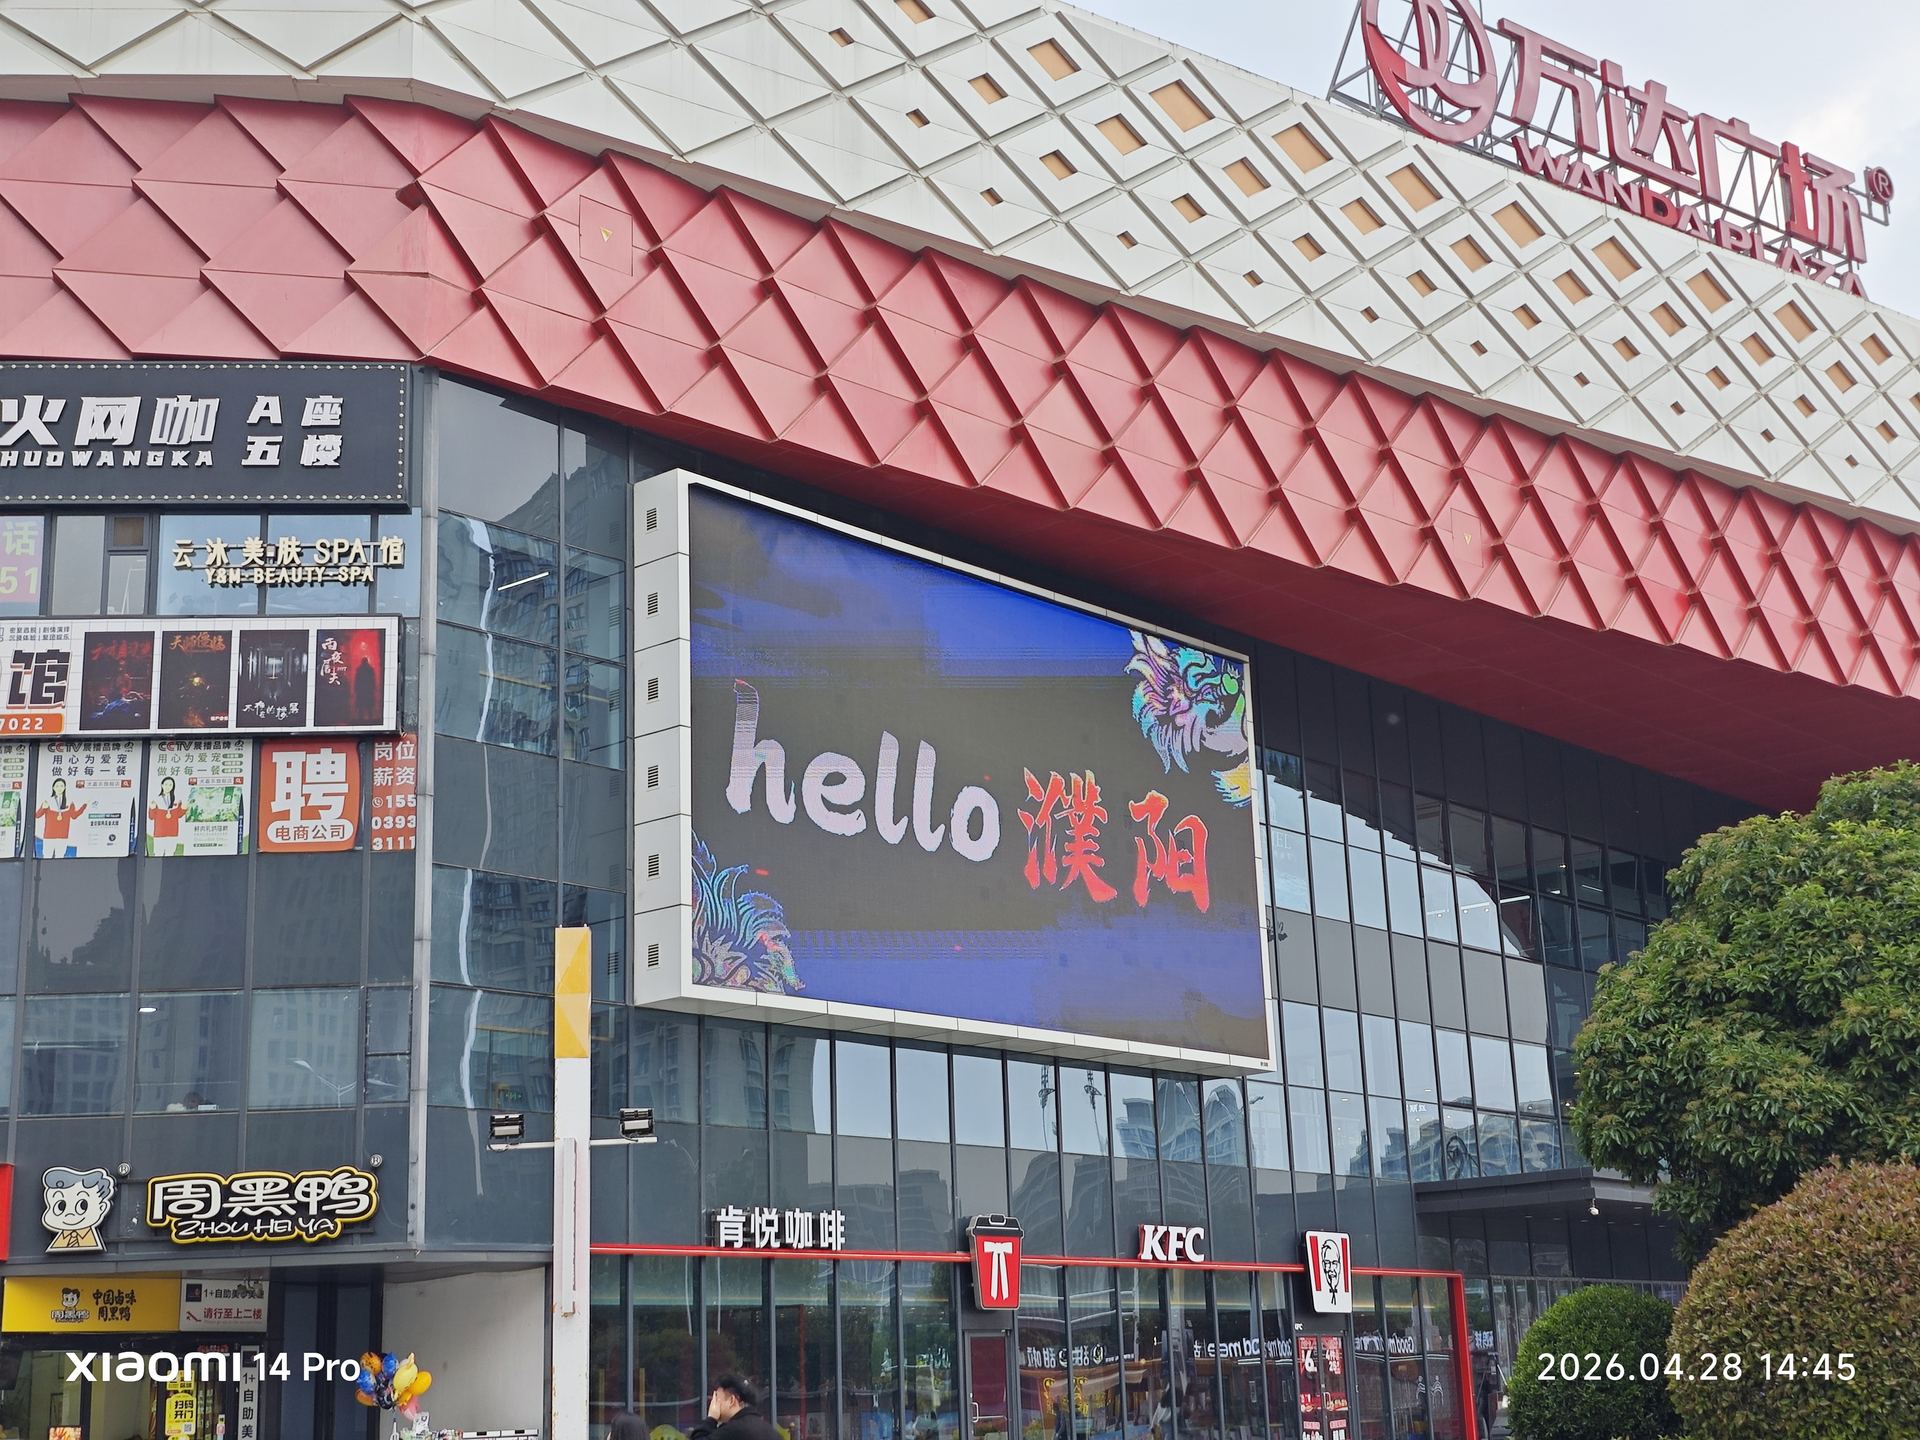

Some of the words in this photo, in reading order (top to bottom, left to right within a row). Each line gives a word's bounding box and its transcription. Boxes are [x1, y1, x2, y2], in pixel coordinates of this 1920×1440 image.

[1498, 18, 1867, 264] 万达广场
[1511, 135, 1709, 240] WANDA
[0, 394, 220, 446] 火网咖
[246, 395, 344, 427] A座
[241, 434, 343, 466] 五楼
[3, 521, 39, 556] 话
[52, 754, 128, 765] 用心为爱宠
[157, 752, 221, 764] 用心为爱宠
[374, 741, 415, 761] 岗位
[51, 766, 127, 777] 做好每一餐
[157, 765, 220, 776] 做好每一餐
[373, 767, 415, 786] 薪资
[270, 748, 349, 821] 聘
[726, 679, 1000, 862] hello
[1017, 766, 1210, 914] 濮阳
[275, 824, 345, 841] 电商公司
[152, 1172, 370, 1219] 周黑鸭
[177, 1219, 250, 1236] ZHOU
[256, 1218, 292, 1234] HEI
[299, 1217, 336, 1235] YA
[716, 1205, 846, 1251] 肯悦咖啡
[1139, 1224, 1205, 1263] KFC
[92, 1288, 137, 1306] 中国卤味
[97, 1305, 131, 1322] 周黑鸭
[203, 1307, 262, 1320] 请行至上二楼
[174, 1400, 194, 1409] 扫码
[174, 1410, 194, 1419] 开门
